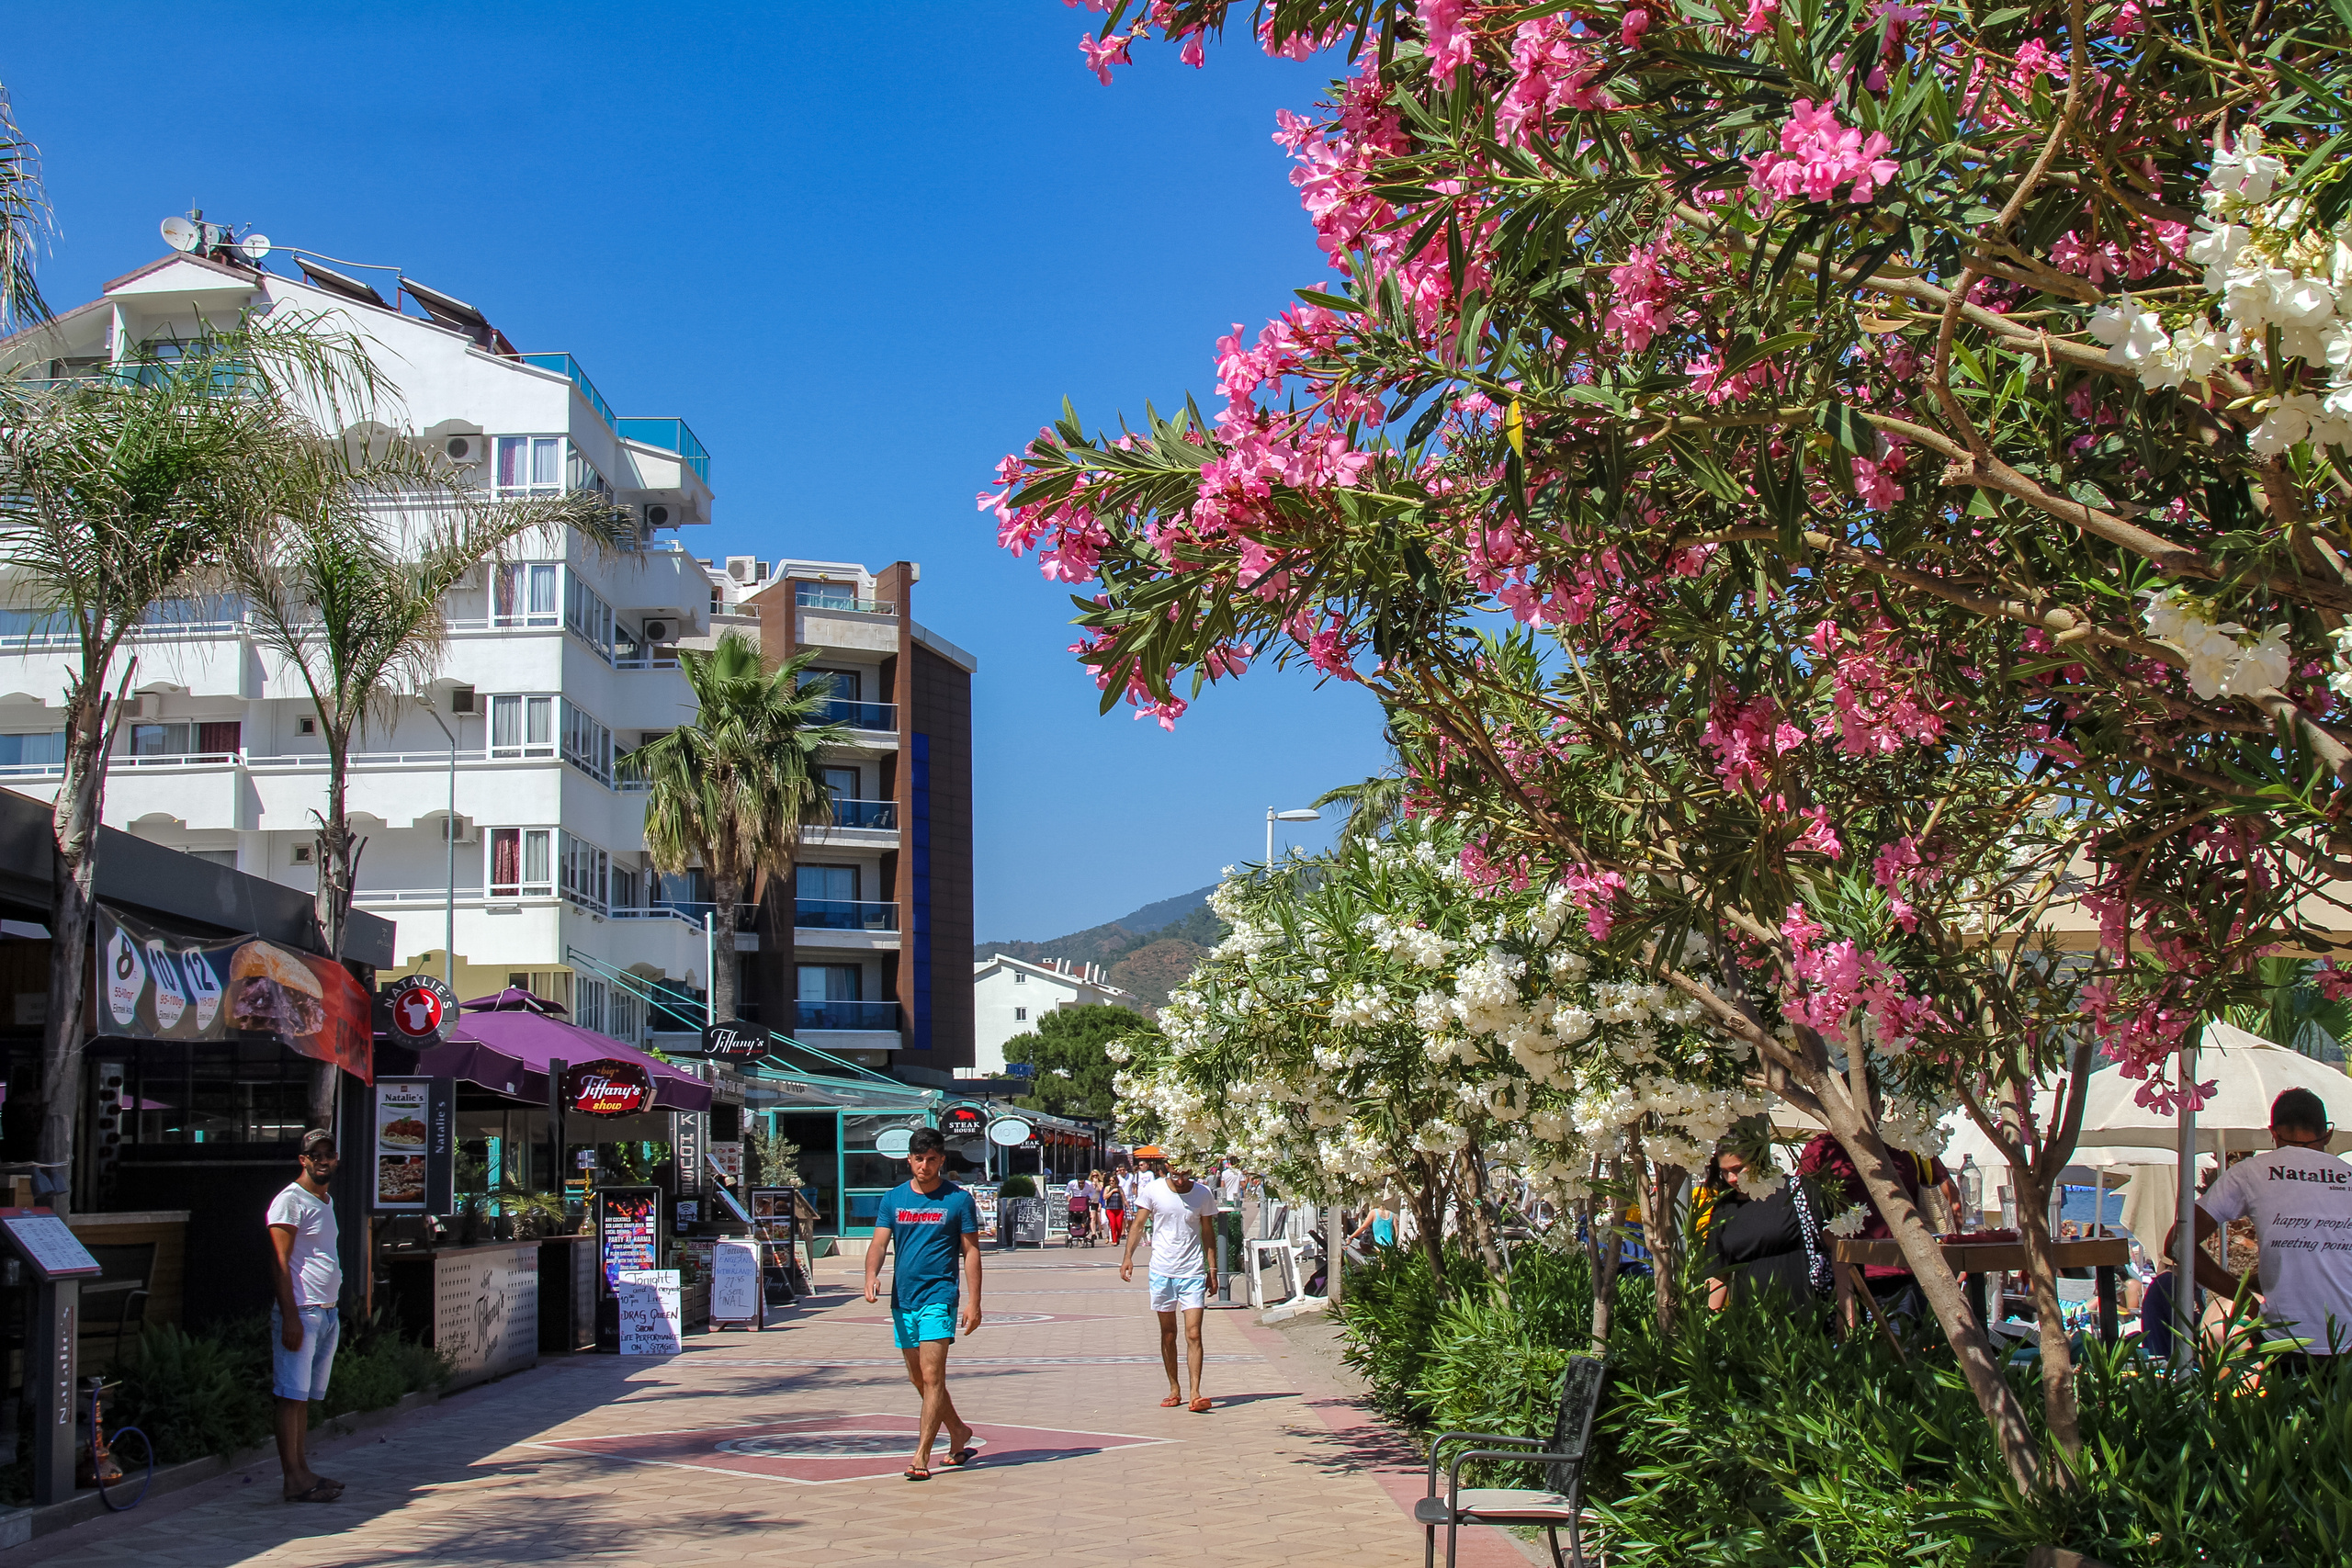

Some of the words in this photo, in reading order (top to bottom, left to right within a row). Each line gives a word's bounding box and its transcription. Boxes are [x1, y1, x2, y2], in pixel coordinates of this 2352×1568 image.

[117, 934, 134, 980] 8
[149, 948, 177, 991] 10
[185, 951, 216, 991] 12
[384, 976, 453, 1010] NATALIE'S
[705, 1028, 764, 1056] Tiffany's
[601, 1066, 615, 1078] big
[574, 1075, 641, 1100] Tiffany's
[385, 1093, 424, 1101] Natalie's
[593, 1099, 622, 1110] show
[435, 1101, 446, 1154] Natalie's
[680, 1134, 695, 1193] HOUSE
[2268, 1165, 2352, 1184] Natalie'
[1016, 1198, 1037, 1206] LARGE
[898, 1211, 943, 1222] Wherever
[1017, 1213, 1036, 1223] EFES
[2272, 1213, 2312, 1229] happy
[2314, 1217, 2352, 1231] people
[2270, 1235, 2319, 1252] meeting
[625, 1271, 673, 1291] Tonight
[718, 1289, 750, 1307] FINAL
[474, 1290, 504, 1353] Tiffany's
[623, 1310, 647, 1324] DRAG
[650, 1307, 679, 1323] QUEEN
[635, 1322, 655, 1332] SHOW
